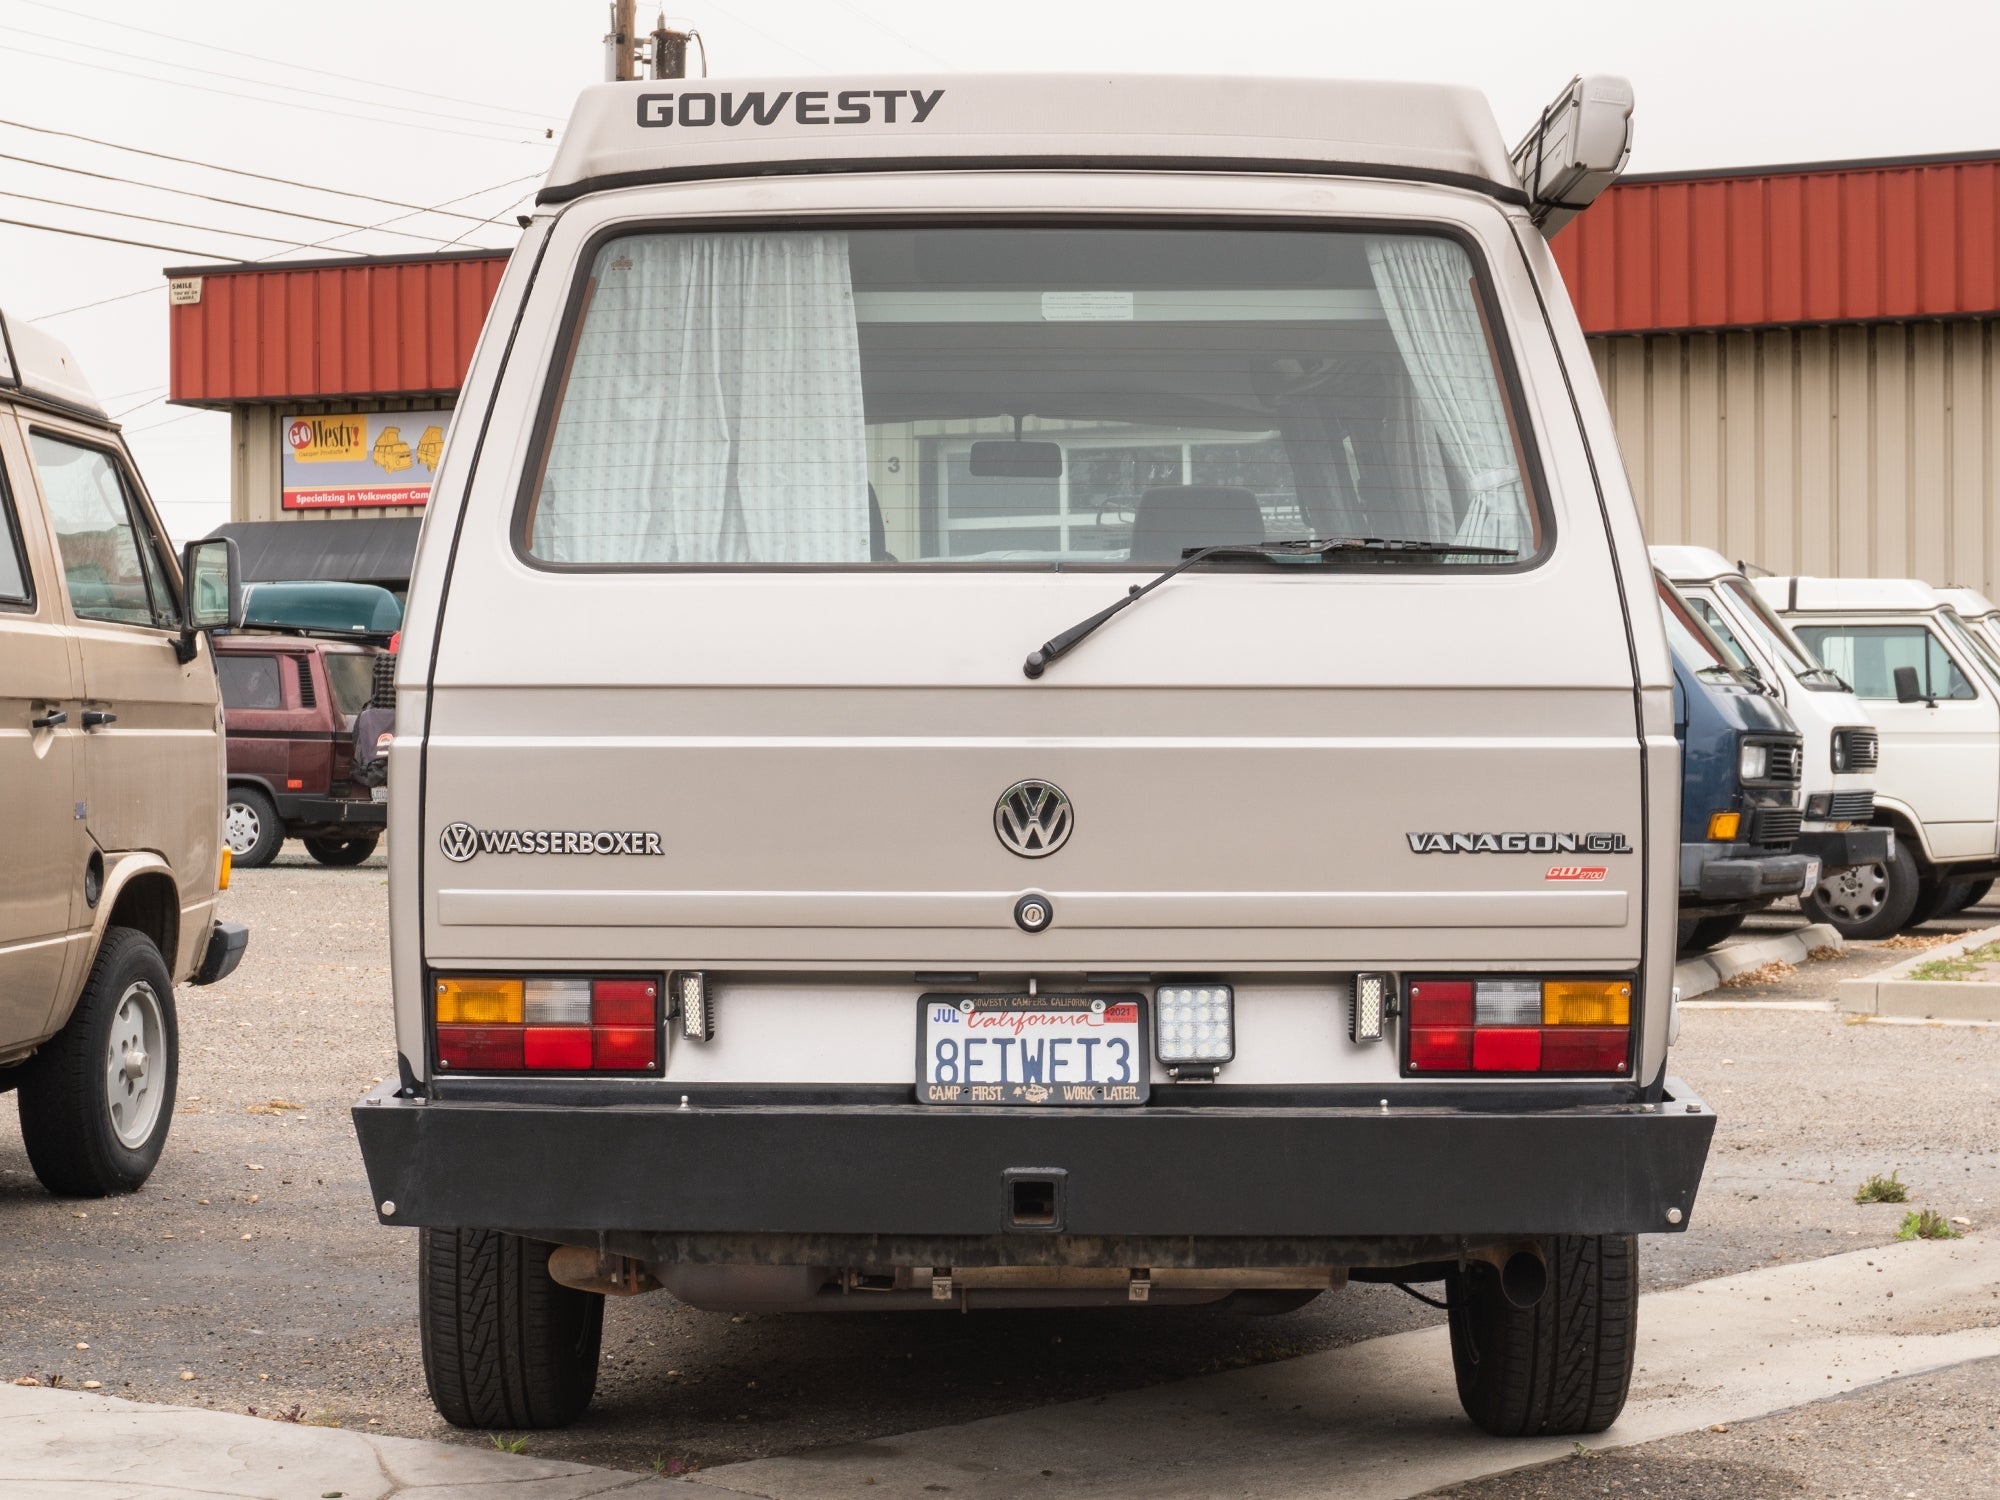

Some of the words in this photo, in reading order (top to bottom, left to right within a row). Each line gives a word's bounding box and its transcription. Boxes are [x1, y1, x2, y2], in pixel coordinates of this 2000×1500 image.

[637, 89, 946, 128] GOWESTY
[172, 282, 192, 290] SMILE
[887, 456, 900, 474] 3
[296, 493, 345, 504] Specializing
[347, 492, 355, 501] in
[410, 490, 430, 500] Cam
[480, 831, 664, 855] WASSERBOXER
[1406, 832, 1577, 853] VANAGON
[1587, 832, 1633, 853] GL
[973, 997, 1009, 1007] GOWESTY
[1050, 997, 1093, 1008] CALIFORNIA
[933, 1008, 960, 1023] JUL
[1110, 1007, 1131, 1017] 2021
[967, 1010, 1104, 1036] California
[928, 1085, 961, 1101] CAMP
[971, 1085, 1006, 1101] FIRST.
[1062, 1085, 1096, 1101] WORK
[1103, 1085, 1140, 1101] LATER.
